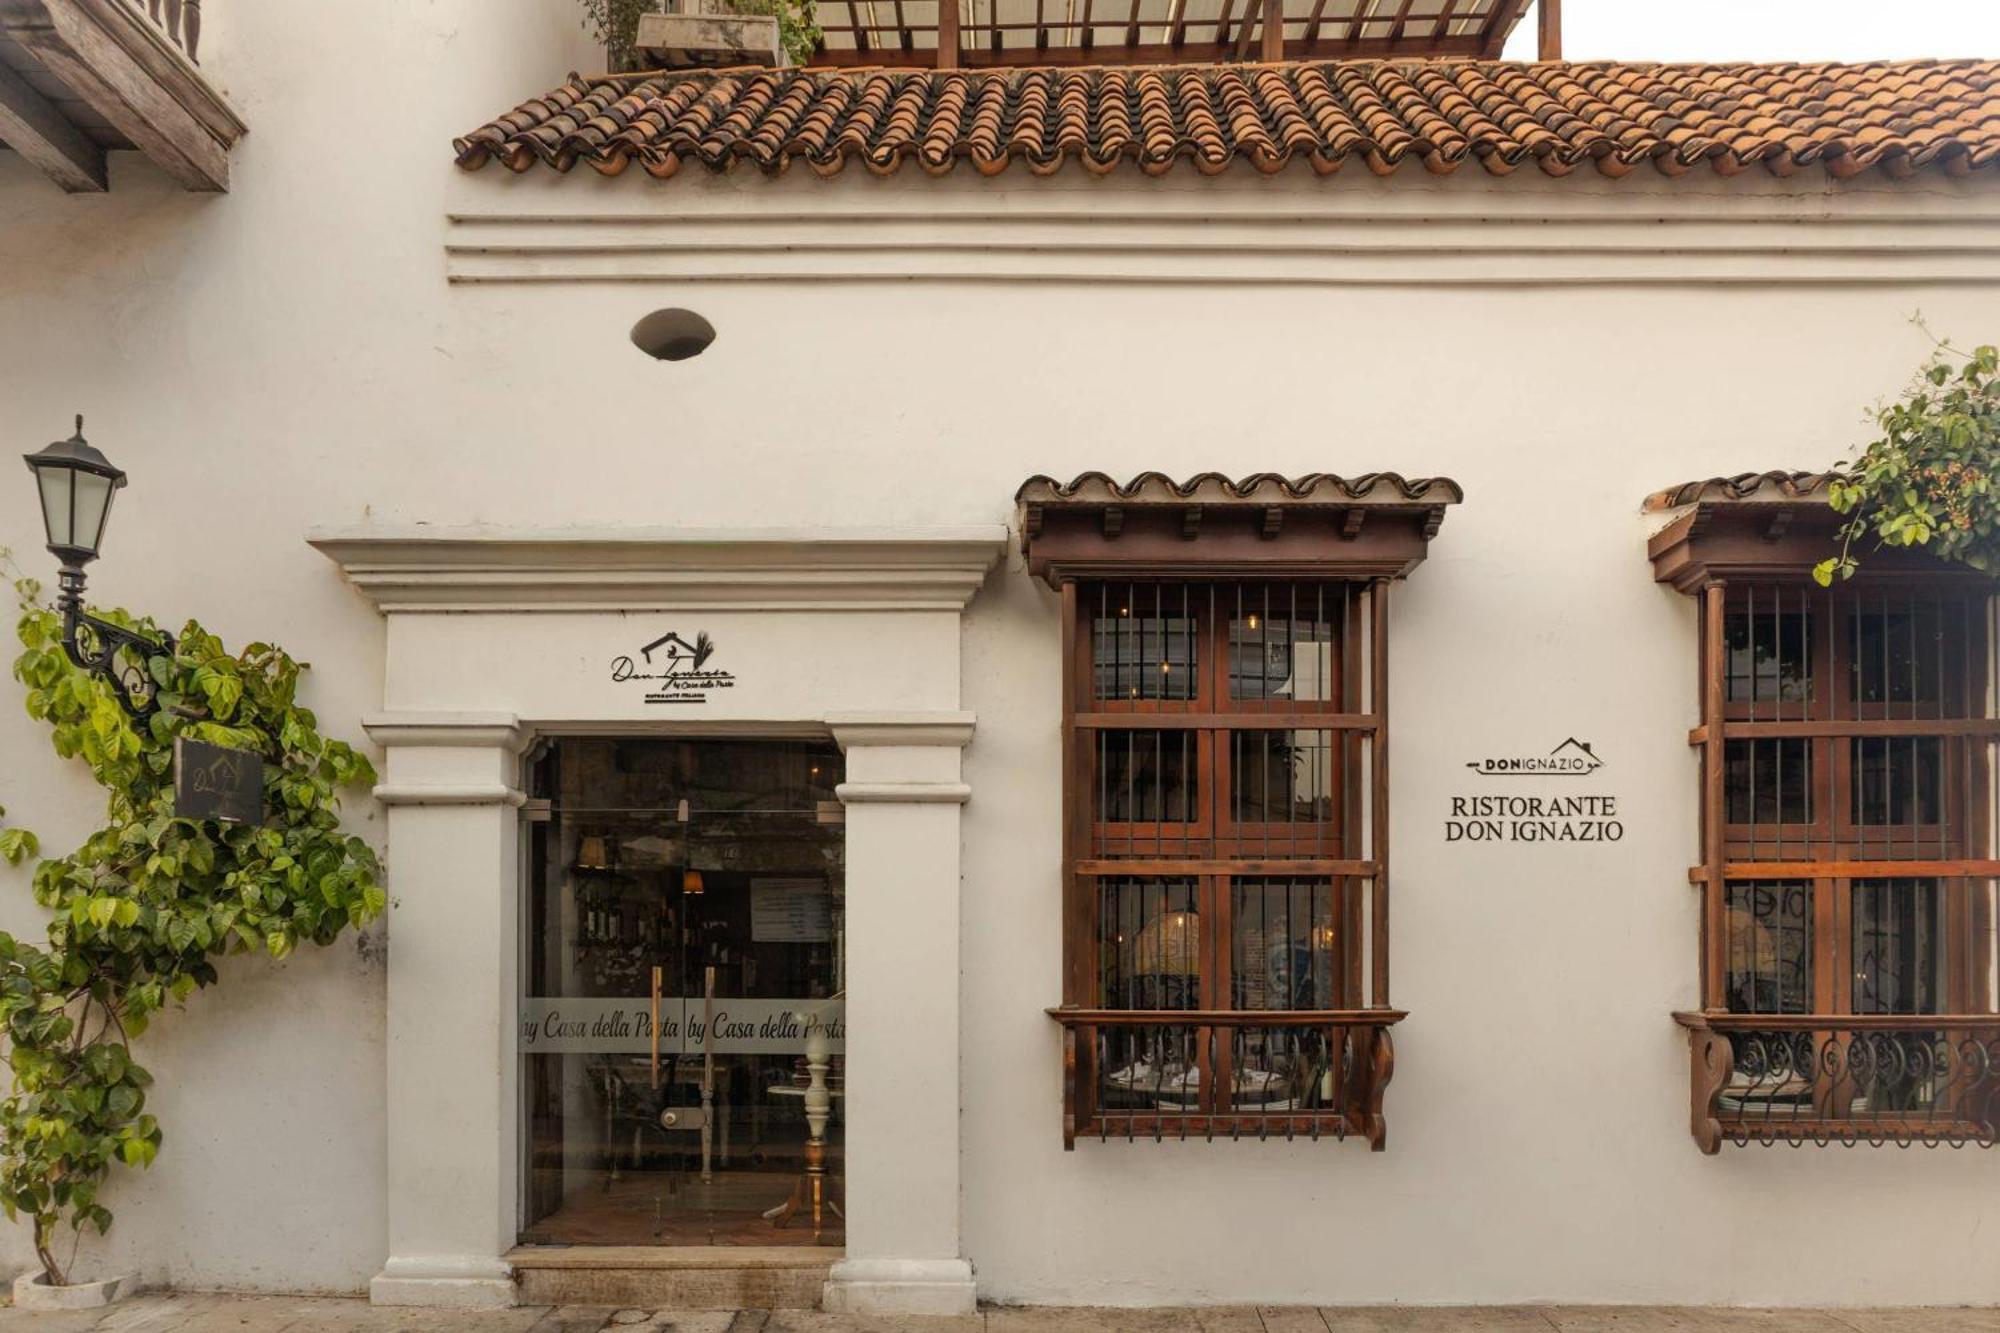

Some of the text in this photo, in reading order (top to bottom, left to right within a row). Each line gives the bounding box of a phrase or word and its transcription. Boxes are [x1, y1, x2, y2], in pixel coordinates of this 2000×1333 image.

[1451, 796, 1617, 817] RISTORANTE
[1445, 820, 1624, 842] DON IGNAZIO
[543, 1010, 585, 1038] Casa
[591, 1010, 629, 1038] della
[687, 1014, 706, 1044] by
[712, 1012, 753, 1039] Casa
[760, 1011, 797, 1039] della
